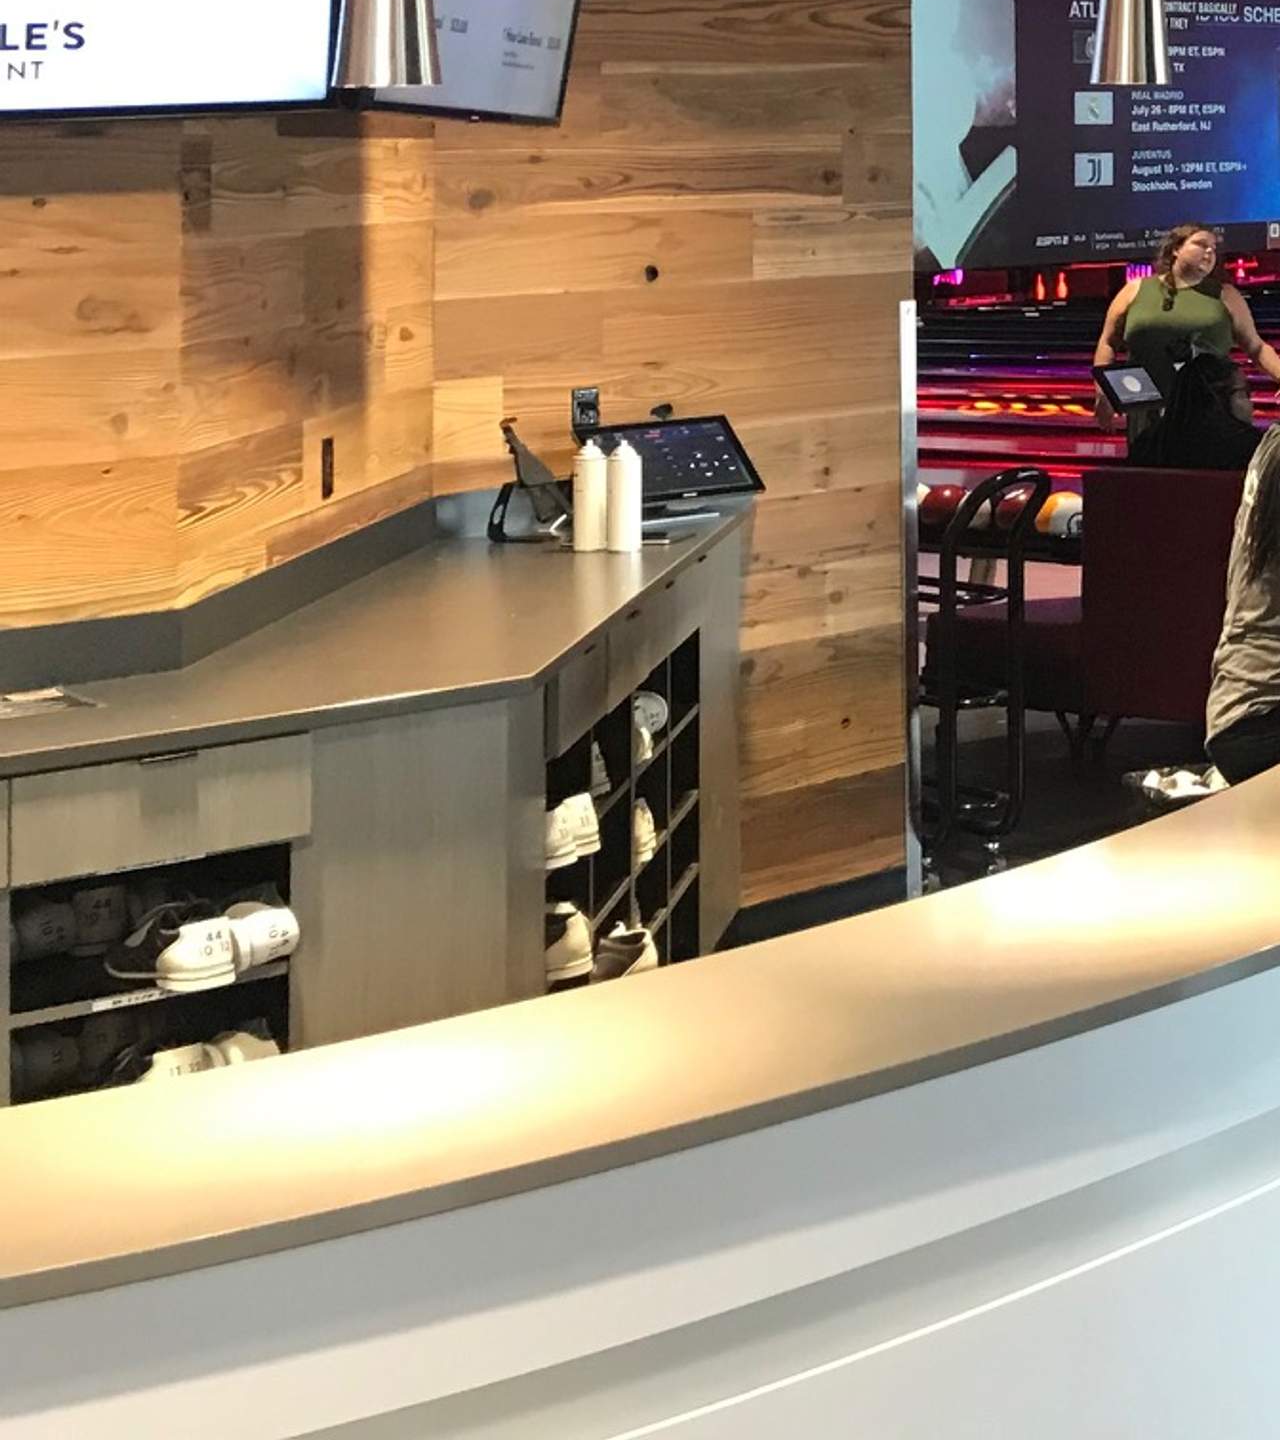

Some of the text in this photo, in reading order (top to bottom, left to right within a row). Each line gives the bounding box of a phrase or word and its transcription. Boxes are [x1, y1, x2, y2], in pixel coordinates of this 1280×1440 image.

[1131, 105, 1149, 117] July
[1131, 121, 1150, 133] East
[1200, 120, 1212, 131] NJ
[1131, 164, 1163, 176] August
[1164, 163, 1174, 173] 10
[1180, 178, 1213, 190] Sweden
